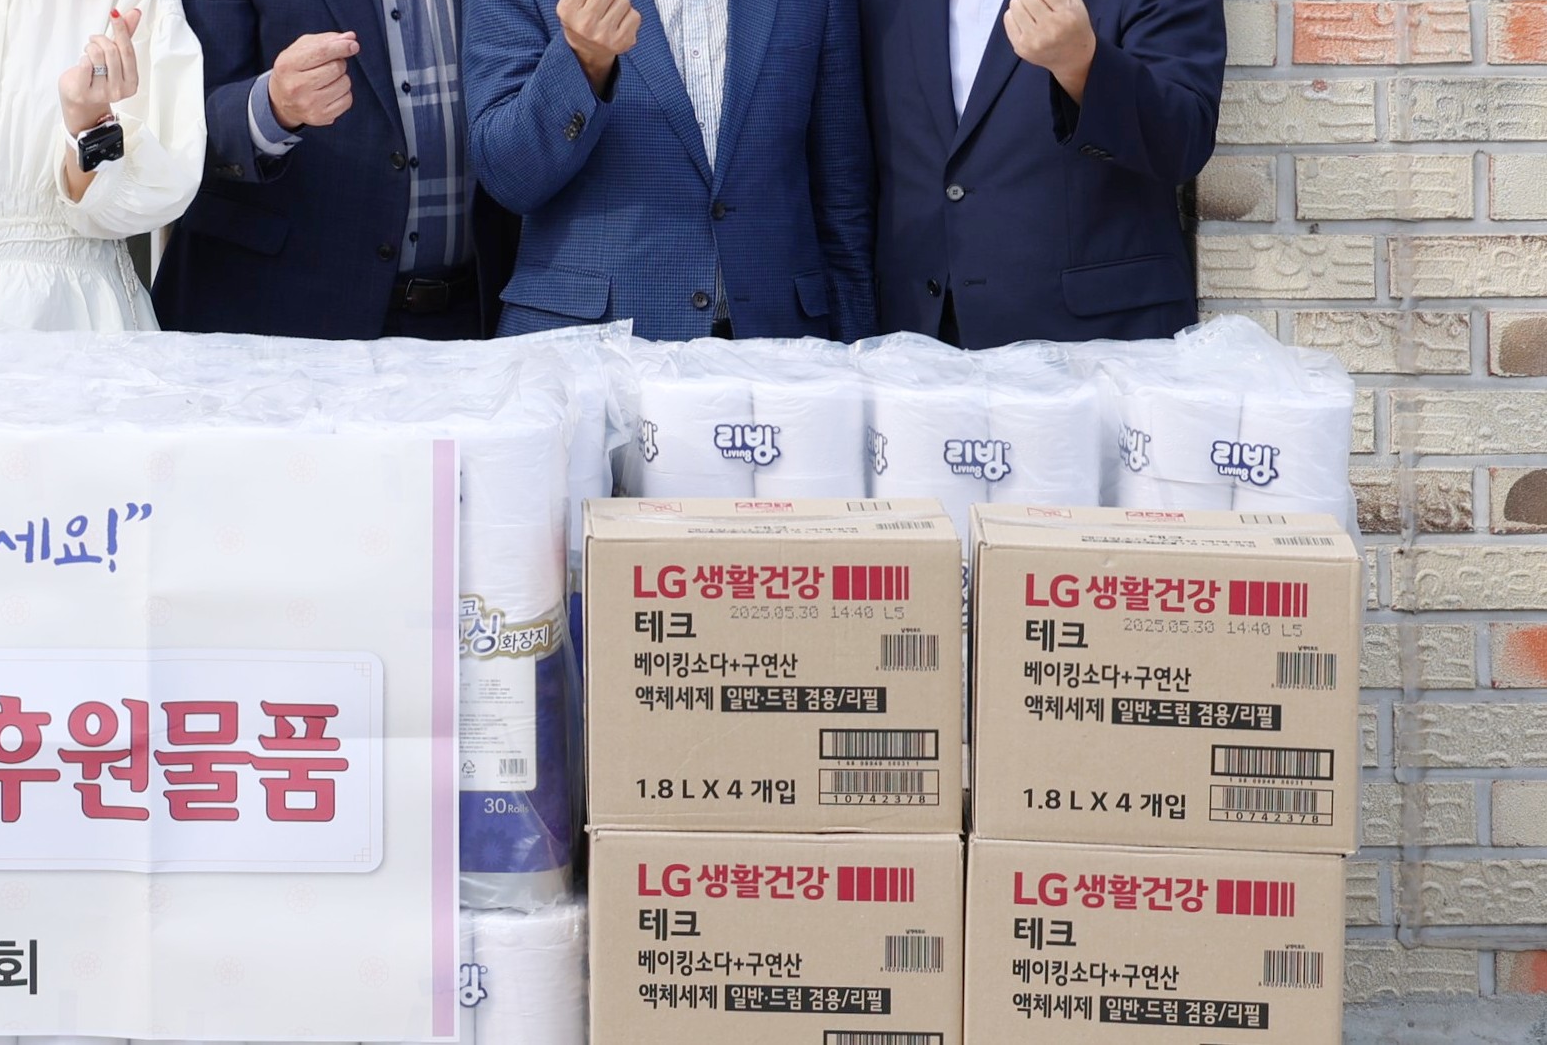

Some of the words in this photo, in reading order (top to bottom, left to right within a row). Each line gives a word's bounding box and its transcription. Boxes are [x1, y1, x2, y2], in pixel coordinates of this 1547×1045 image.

[715, 424, 780, 466] 리빙
[944, 439, 1012, 482] 리빙
[1211, 441, 1280, 486] 리빙
[633, 565, 687, 599] LG
[692, 565, 825, 600] 생활건강
[1025, 573, 1080, 608] LG
[1085, 576, 1222, 614] 생활건강
[634, 611, 697, 643] 테크
[729, 605, 819, 620] 2025.05.30
[1122, 617, 1215, 634] 2025.05.30
[501, 626, 548, 652] 화장지
[1025, 619, 1089, 653] 테크
[634, 652, 798, 678] 베이킹소다+구연산
[1023, 661, 1193, 693] 베이킹소다+구연산
[635, 685, 714, 712] 액체세제
[804, 688, 879, 711] 겸용/리필
[1023, 695, 1105, 722] 액체세제
[1196, 703, 1274, 730] 겸용/리필
[484, 798, 507, 815] 30
[508, 803, 529, 814] Rolls
[636, 779, 674, 799] 1.8
[682, 779, 695, 799] L
[702, 779, 720, 799] X
[726, 779, 744, 799] 4
[750, 779, 797, 805] 개입
[833, 793, 927, 804] 10742378
[1023, 788, 1062, 809] 1.8
[1069, 791, 1083, 811] L
[1090, 792, 1109, 812] X
[1115, 792, 1132, 813] 4
[1139, 793, 1187, 820] 개입
[1223, 811, 1320, 824] 10742378
[637, 863, 692, 898] LG
[696, 863, 830, 900] 생활건강
[1013, 871, 1069, 907] LG
[1073, 874, 1209, 913] 생활건강
[639, 908, 701, 941] 테크
[1013, 917, 1077, 951] 테크
[637, 950, 803, 979] 베이킹소다+구연산
[1012, 959, 1180, 991] 베이킹소다+구연산
[638, 983, 718, 1010] 액체세제
[808, 988, 883, 1012] 겸용/리필
[1012, 993, 1093, 1021] 액체세제
[1184, 1002, 1261, 1028] 겸용/리필
